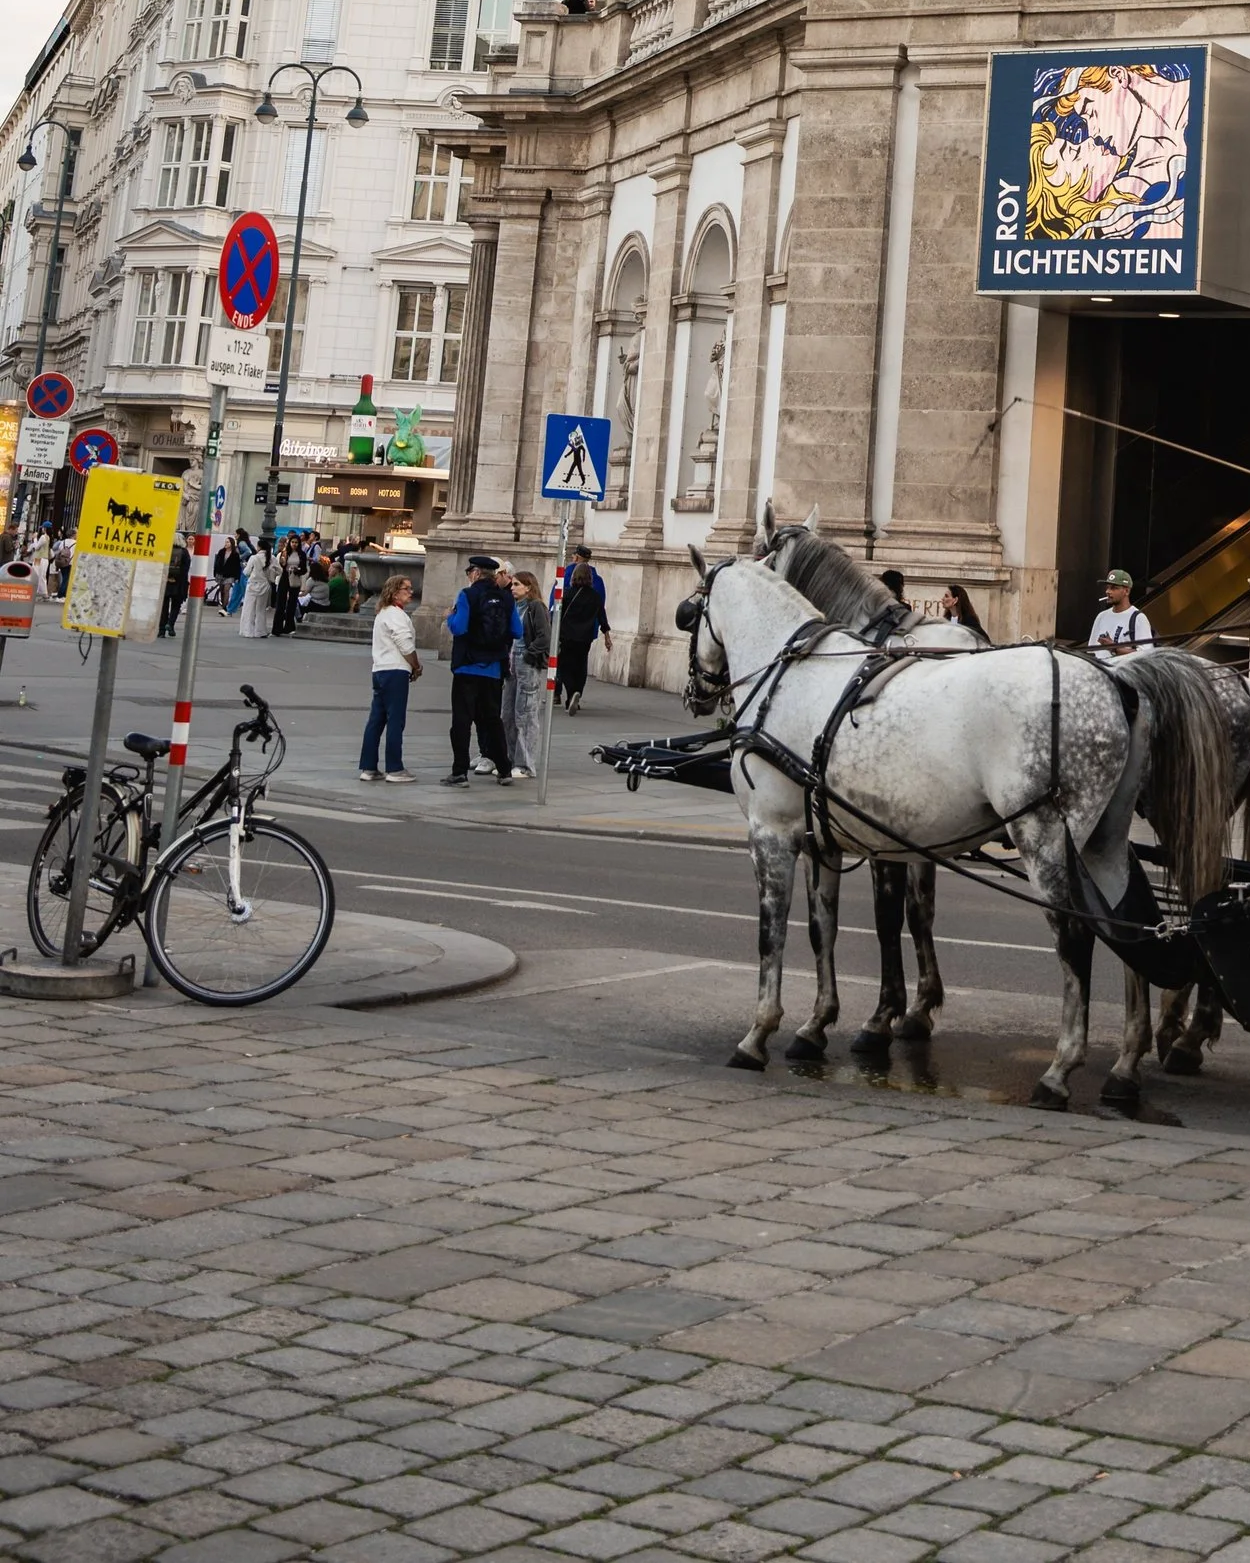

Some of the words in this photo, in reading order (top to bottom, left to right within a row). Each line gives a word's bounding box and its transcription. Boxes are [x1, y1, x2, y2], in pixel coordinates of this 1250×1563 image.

[996, 179, 1020, 240] ROY
[993, 249, 1182, 275] LICHTENSTEIN
[232, 311, 254, 328] ENDE
[211, 360, 236, 376] ausgen.
[238, 362, 243, 375] 2
[244, 364, 264, 379] Fiaker
[24, 468, 51, 481] Anfang
[378, 489, 389, 498] HOT
[389, 489, 401, 498] DOG
[94, 525, 157, 548] FIAKER
[91, 542, 155, 557] RUNDFAHRTEN
